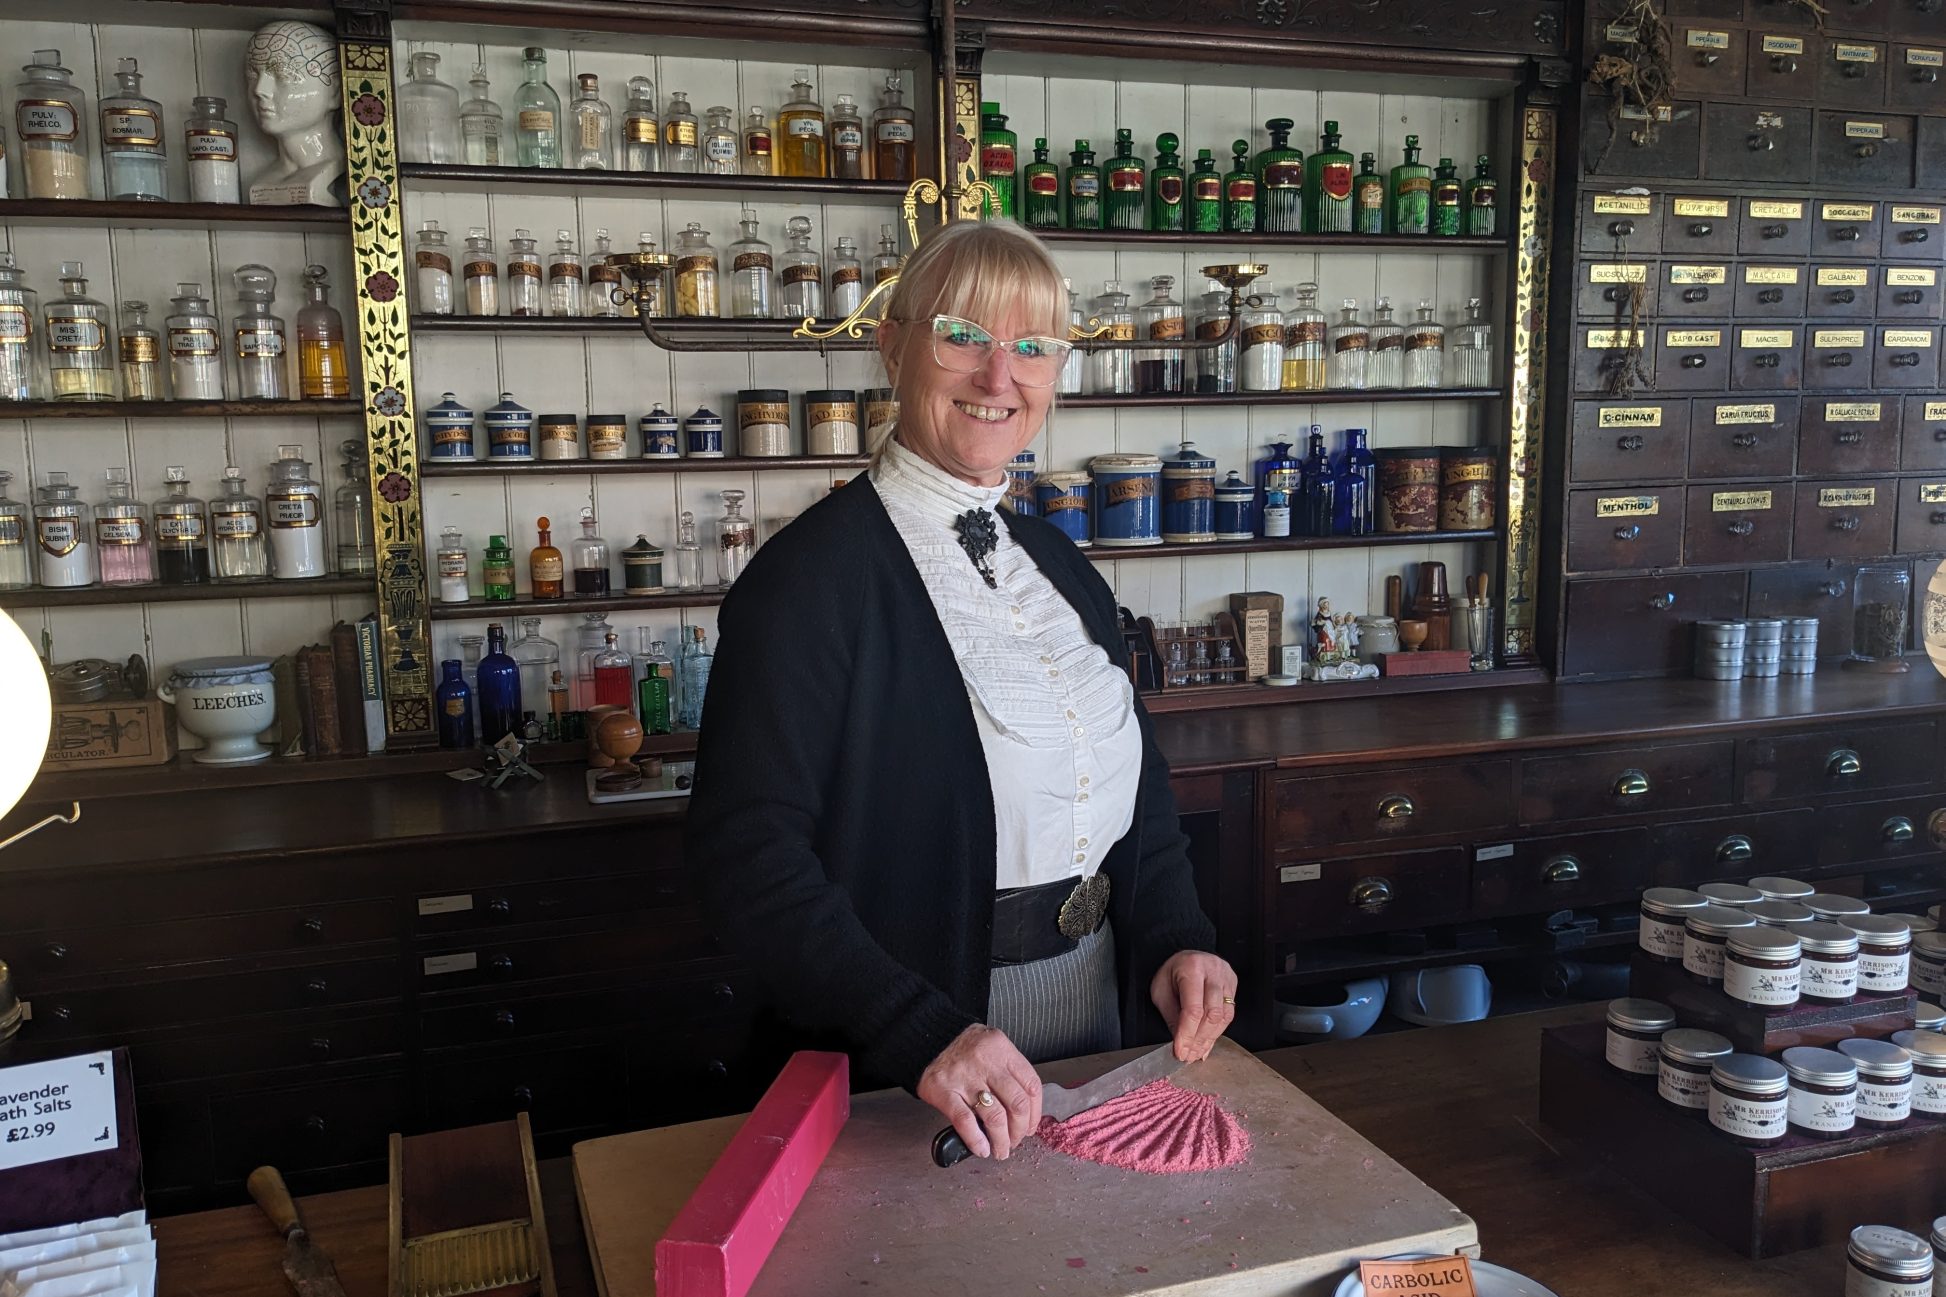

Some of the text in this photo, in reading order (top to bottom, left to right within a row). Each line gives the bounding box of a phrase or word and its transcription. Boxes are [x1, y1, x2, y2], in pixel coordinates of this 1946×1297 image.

[0, 1084, 69, 1105] avender
[1878, 1090, 1912, 1098] KERRISON'
[0, 1098, 72, 1122] ath Salts
[6, 1121, 56, 1143] £2.99
[1370, 1268, 1464, 1290] CARBOLIC
